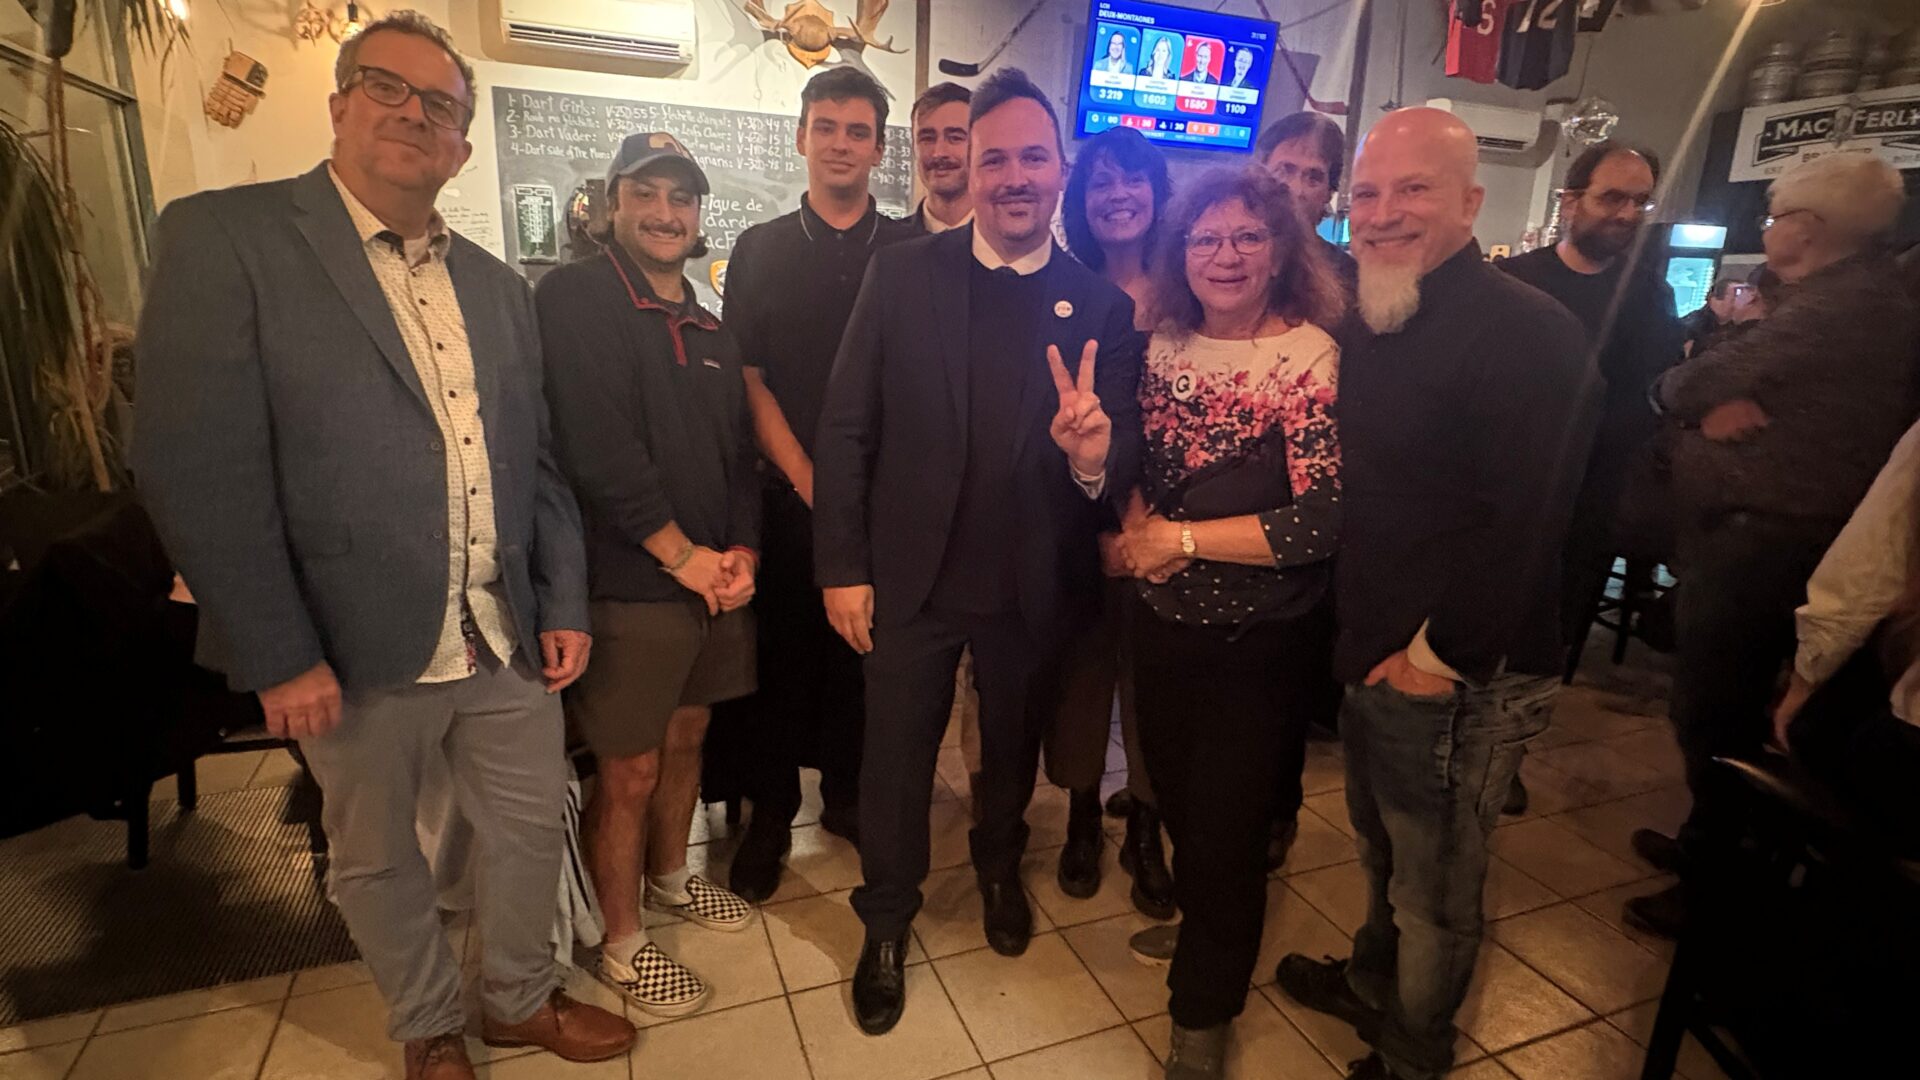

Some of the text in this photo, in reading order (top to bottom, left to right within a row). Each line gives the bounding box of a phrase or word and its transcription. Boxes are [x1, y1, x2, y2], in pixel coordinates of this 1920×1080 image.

[1098, 9, 1155, 24] DEUX-MONTAGNES
[522, 94, 553, 112] Dart
[560, 98, 596, 117] Girls:
[526, 125, 555, 139] Dart
[558, 127, 597, 142] Vader:
[746, 198, 764, 212] de
